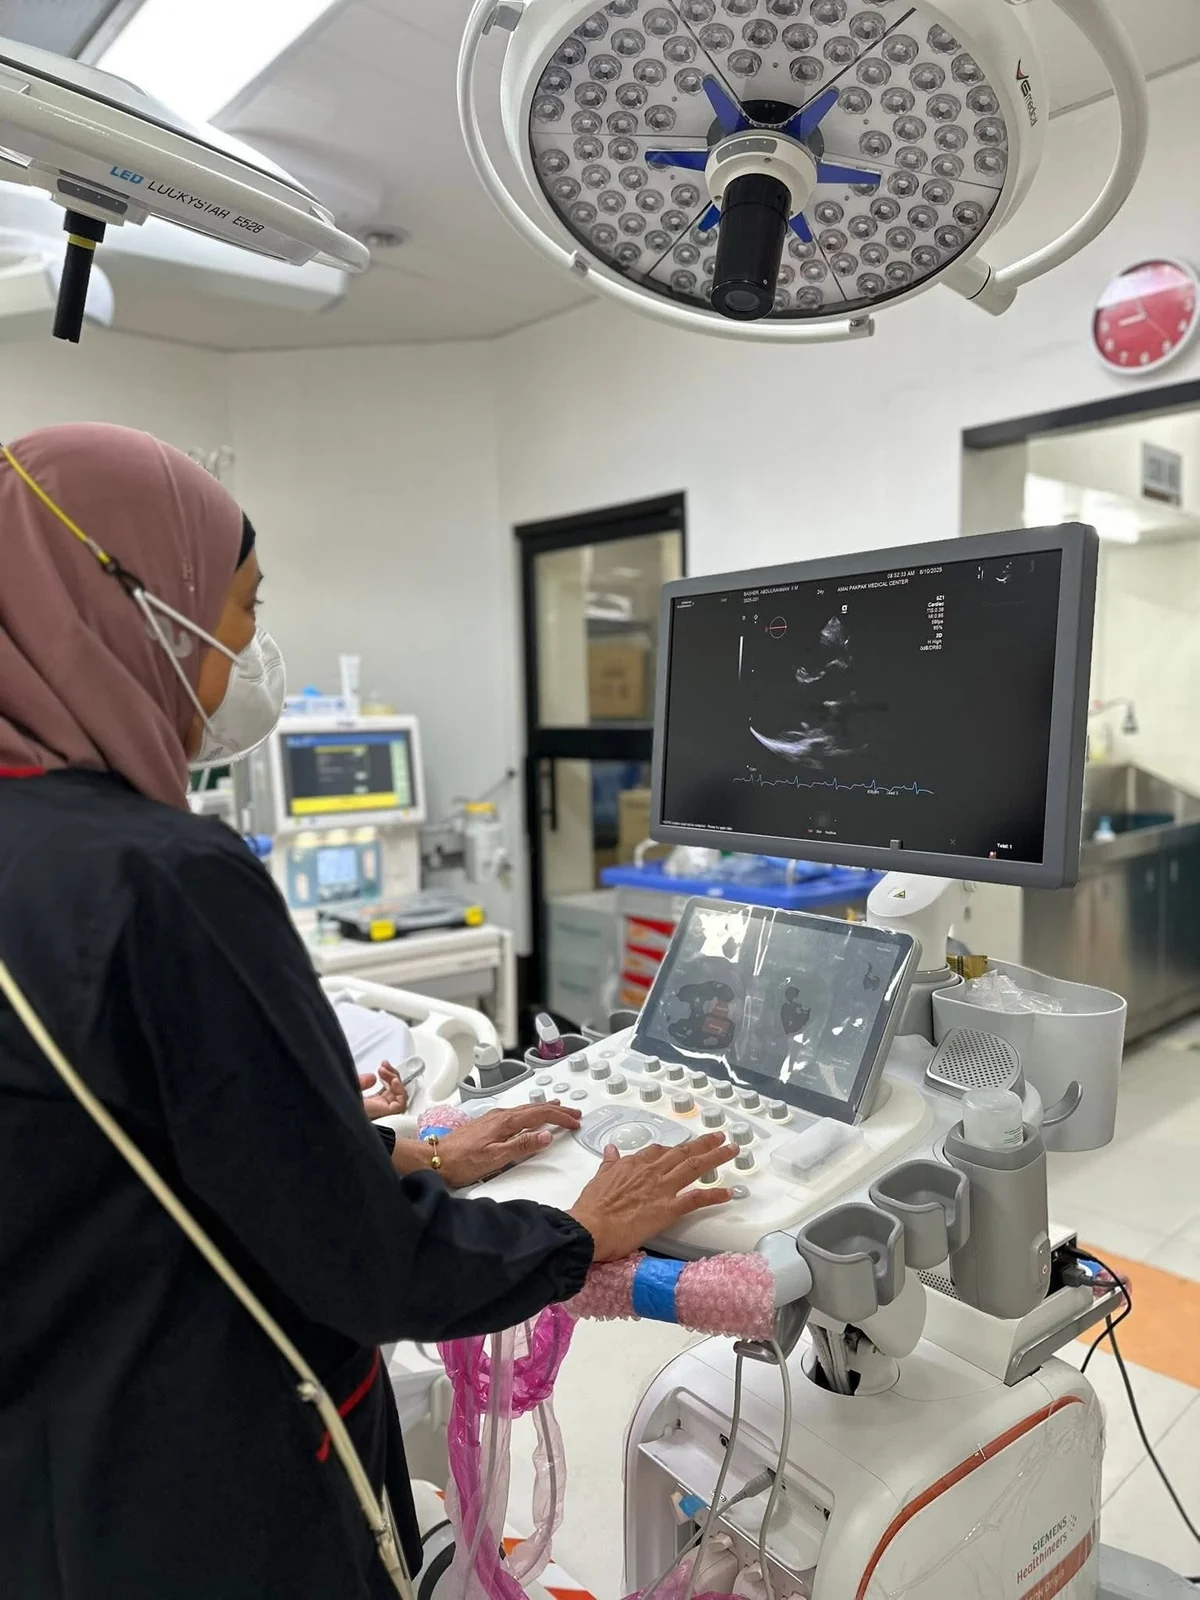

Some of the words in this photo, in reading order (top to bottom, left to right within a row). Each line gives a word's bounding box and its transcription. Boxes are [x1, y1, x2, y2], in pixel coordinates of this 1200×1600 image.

[109, 165, 145, 185] LED
[147, 180, 231, 220] LUCKYSTAR
[232, 215, 265, 234] E528
[889, 578, 909, 586] CENTER
[1016, 1531, 1068, 1585] Healthineers
[1032, 1515, 1068, 1555] SIEMENS
